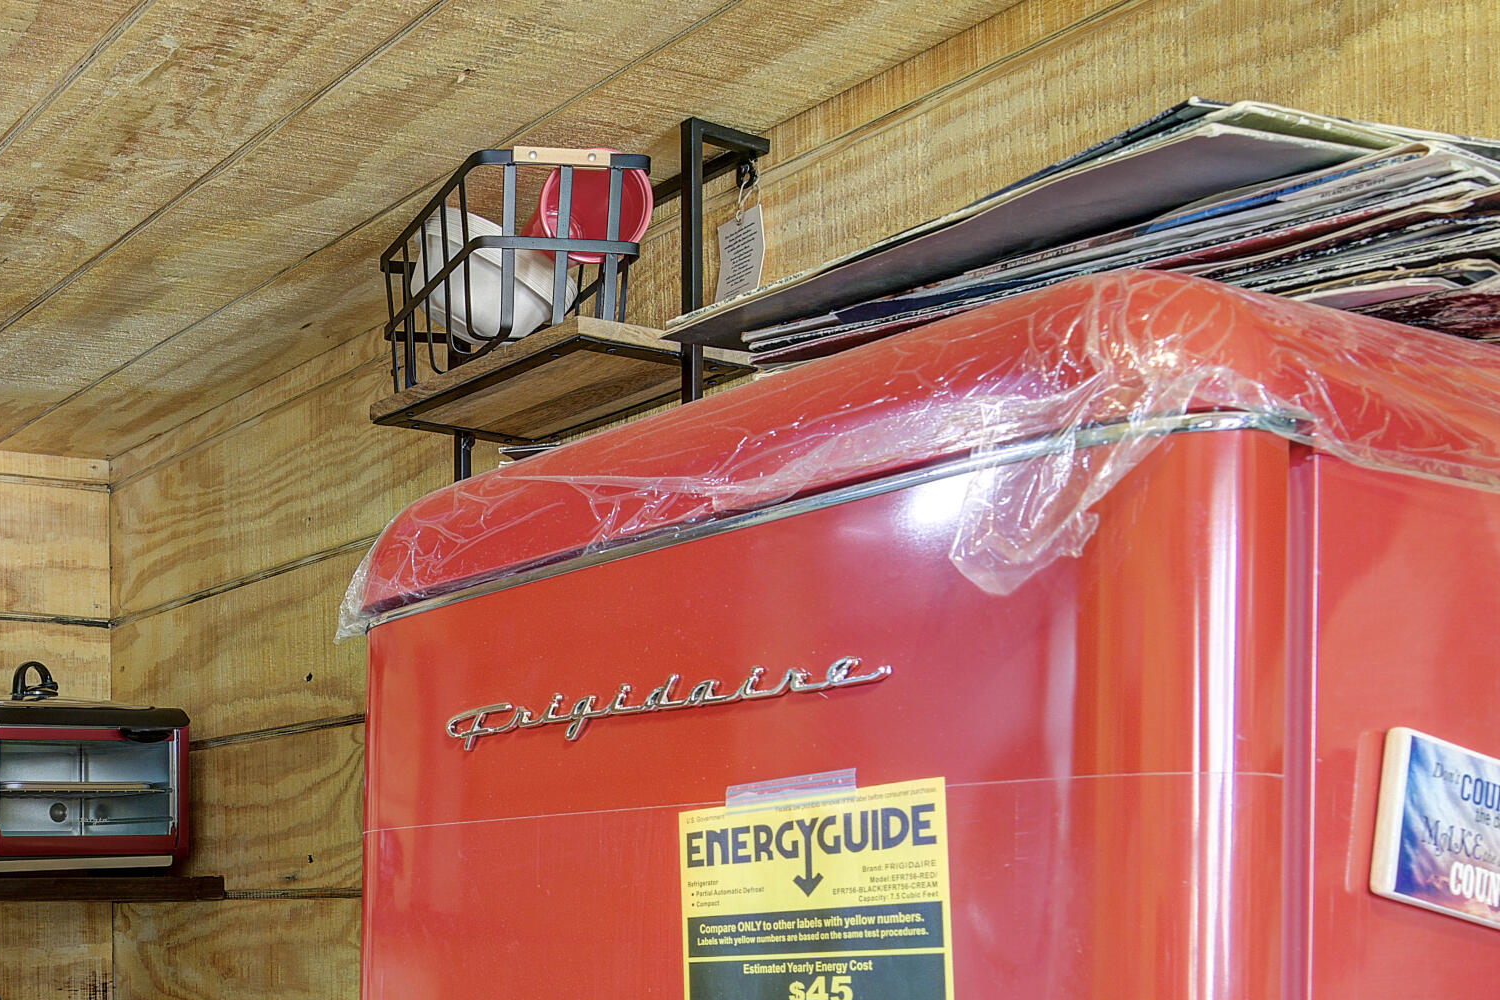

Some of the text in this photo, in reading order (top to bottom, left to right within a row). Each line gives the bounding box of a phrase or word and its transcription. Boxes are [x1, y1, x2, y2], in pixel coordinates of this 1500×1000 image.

[444, 655, 894, 751] Frigidaire
[868, 793, 884, 802] before
[884, 791, 910, 800] consumer
[696, 814, 725, 824] Government
[686, 803, 937, 869] ENERGYGUIDE
[1421, 816, 1484, 860] MAKE
[884, 860, 937, 870] FRIGIDAIRE
[714, 888, 742, 896] Automatic
[700, 912, 924, 936] Compare ONLY to other labels with yellow numbers.
[697, 937, 718, 946] Labels
[719, 936, 733, 945] with
[734, 936, 755, 946] yellow
[757, 934, 786, 943] numbers
[798, 932, 820, 941] based
[830, 930, 842, 939] the
[843, 930, 863, 939] same
[864, 929, 880, 938] test
[880, 926, 929, 939] procedures.
[743, 960, 873, 975] Estimated Yearly Energy Cost
